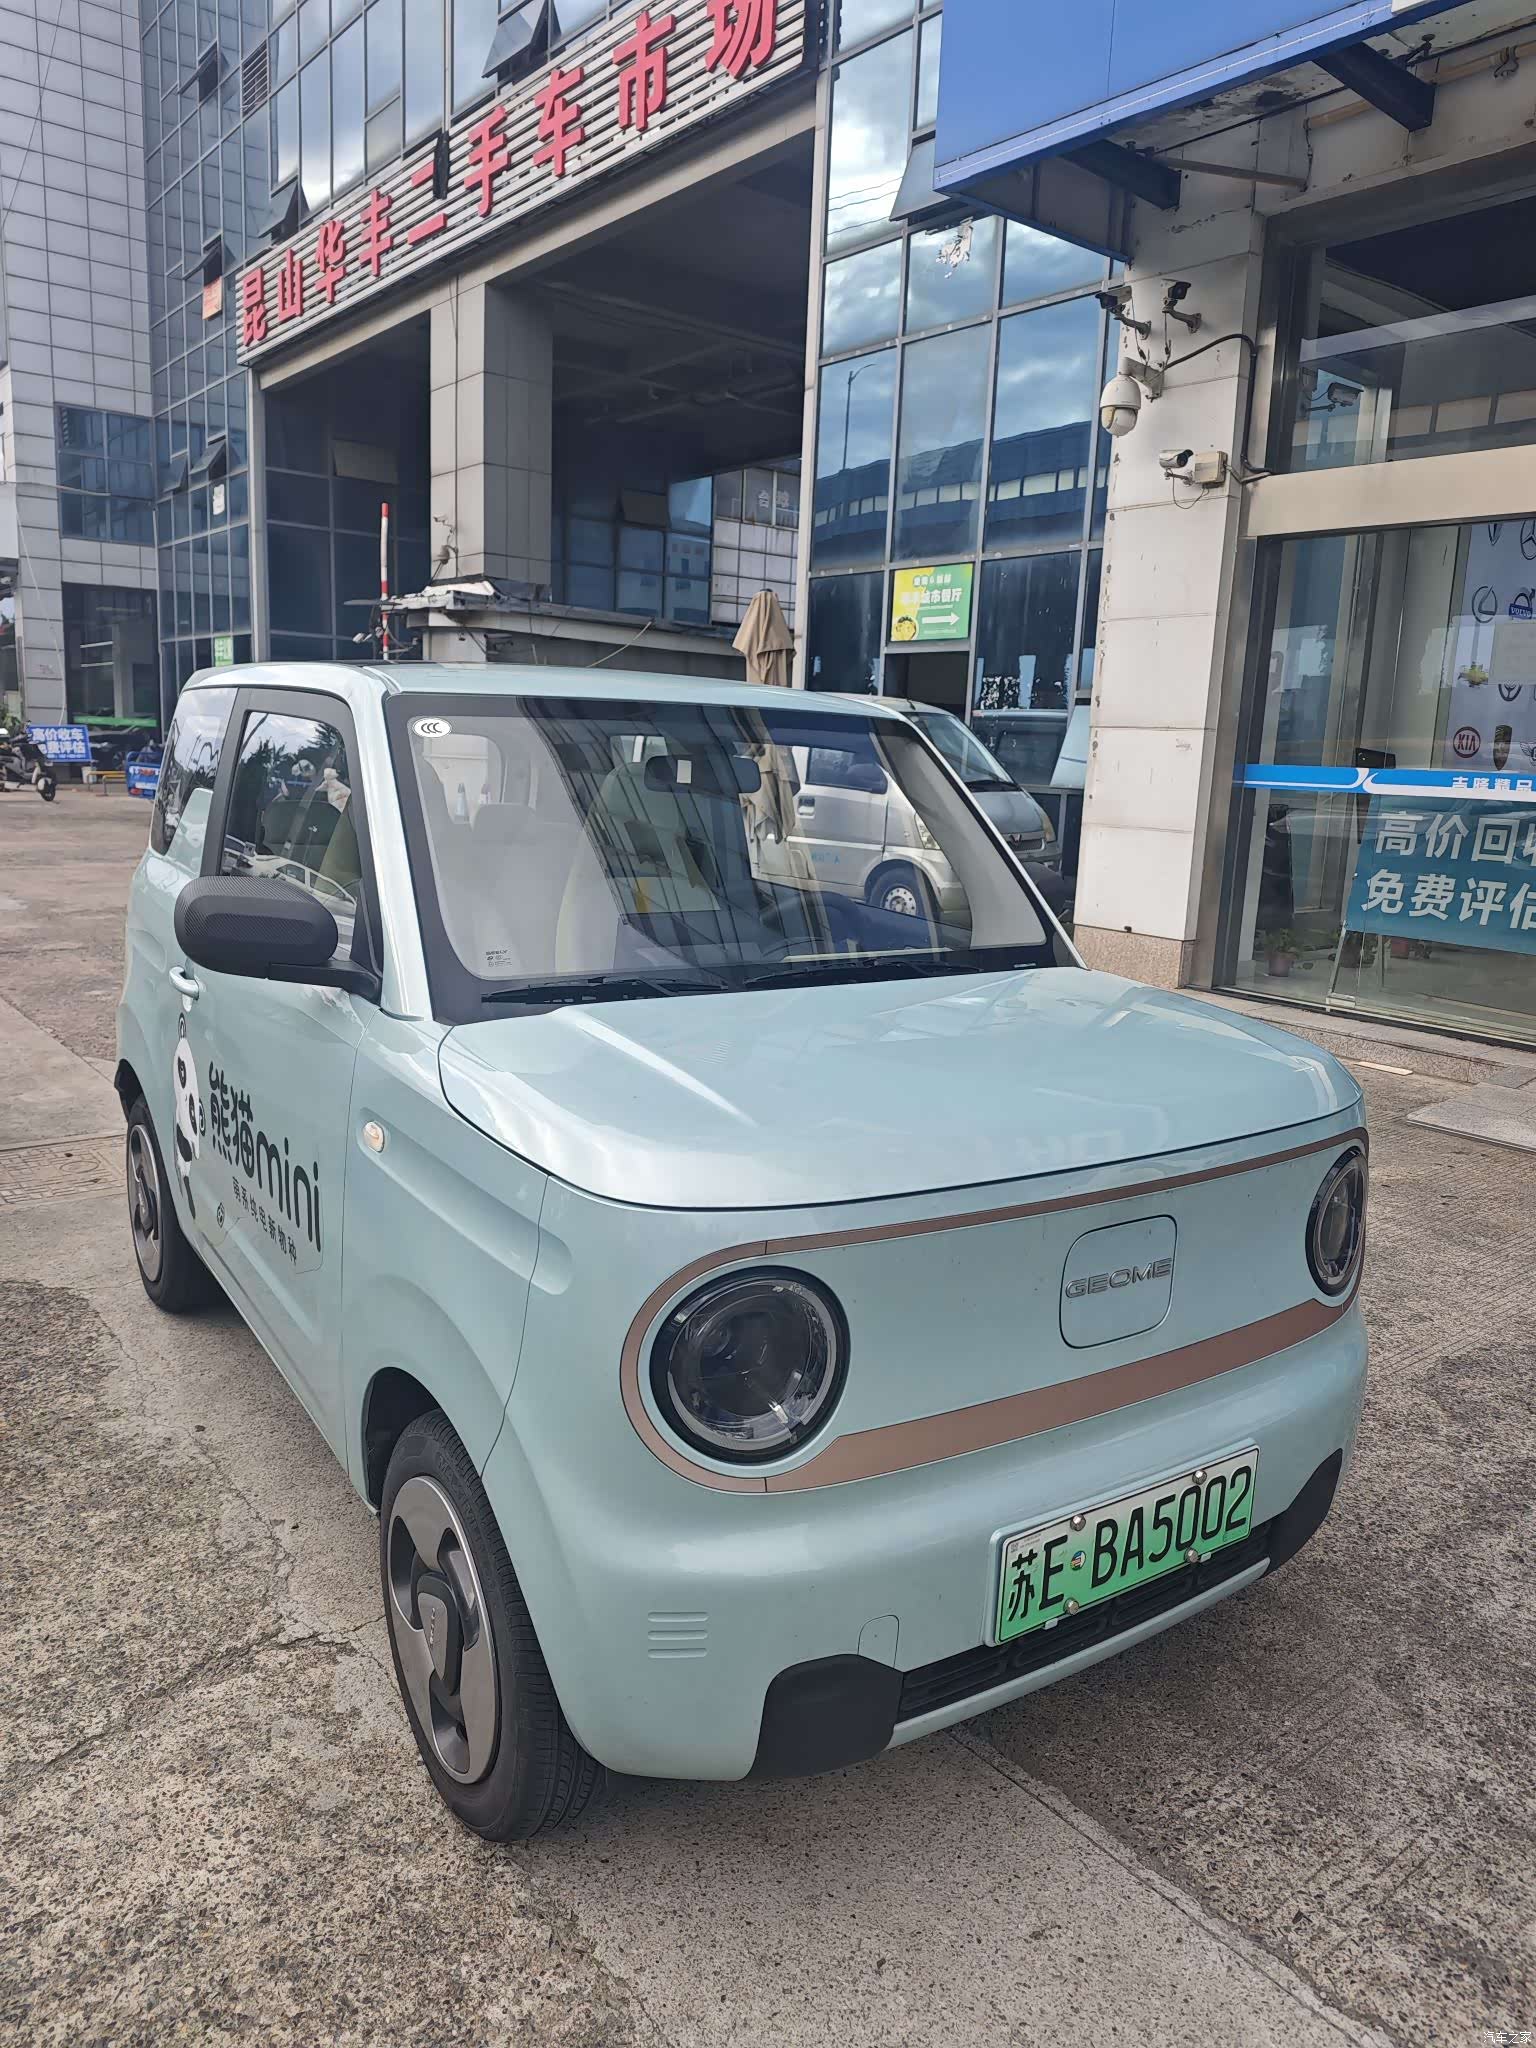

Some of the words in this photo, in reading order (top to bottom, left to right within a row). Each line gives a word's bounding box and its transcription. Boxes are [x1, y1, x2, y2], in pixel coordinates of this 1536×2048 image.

[241, 0, 777, 346] 昆山华丰二手车市场
[1510, 605, 1532, 618] VOLVO
[1457, 733, 1476, 751] KIA
[1065, 1257, 1172, 1298] GEOME
